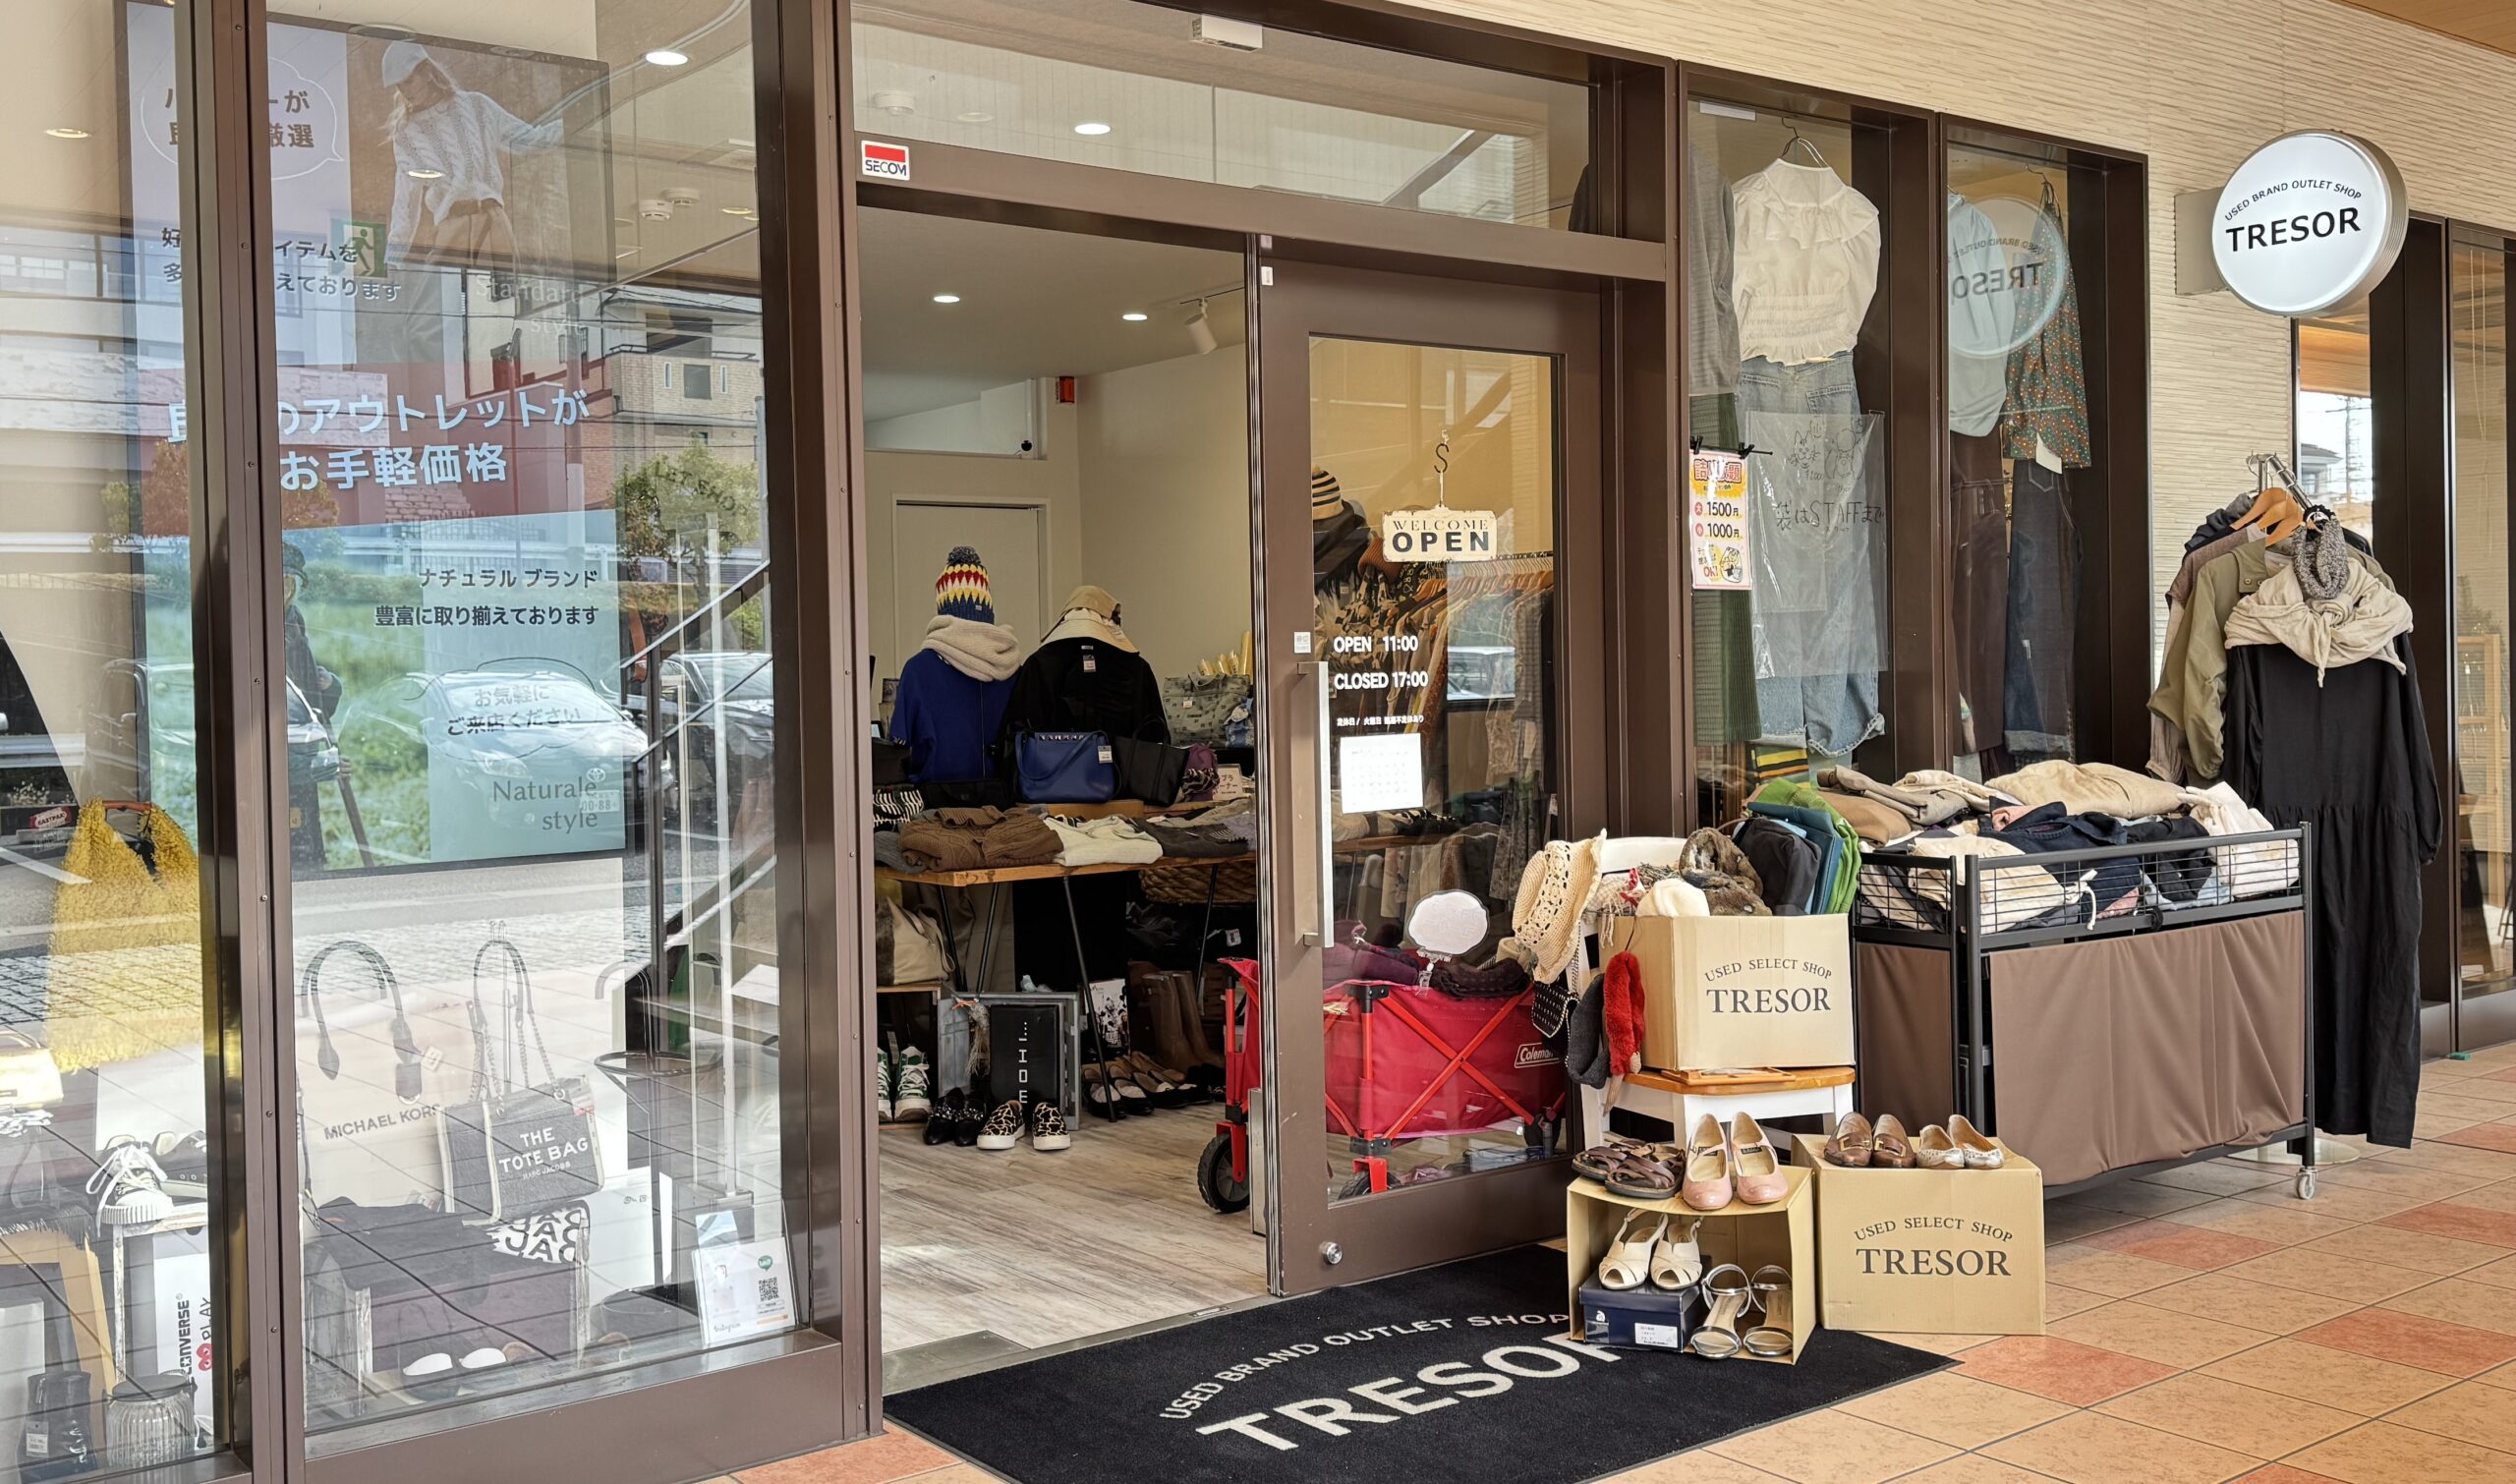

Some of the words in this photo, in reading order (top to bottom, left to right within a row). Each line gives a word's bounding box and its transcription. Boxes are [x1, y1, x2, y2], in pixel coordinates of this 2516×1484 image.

[865, 159, 907, 177] SECOM
[2225, 200, 2250, 221] USED
[2252, 182, 2289, 202] BRAND
[2292, 179, 2332, 190] OUTLET
[2333, 183, 2362, 200] SHOP
[2225, 206, 2361, 252] TRESOR
[1393, 519, 1489, 532] WELCOME
[1392, 532, 1490, 552] OPEN
[420, 569, 516, 588] ナチュラル
[525, 568, 598, 588] ブランド
[375, 605, 599, 626] 豊富に取り揃えております
[1334, 636, 1372, 653] OPEN
[1383, 635, 1418, 653] 11:00
[1334, 671, 1389, 690] CLOSED
[1392, 670, 1428, 688] 17:00
[493, 776, 597, 802] Naturale
[542, 811, 598, 833] style
[1704, 962, 1742, 982] USED
[1748, 958, 1798, 970] SELECT
[1802, 961, 1832, 980] SHOP
[1706, 987, 1831, 1013] TRESOR
[1519, 1047, 1553, 1061] Coleman
[324, 1113, 397, 1140] MICHAEL
[520, 1127, 555, 1148] THE
[499, 1150, 543, 1173] TOTE
[548, 1137, 589, 1160] BAG
[1854, 1220, 1897, 1241] USED
[1904, 1217, 1964, 1229] SELECT
[1972, 1222, 2013, 1243] SHOP
[1856, 1248, 2012, 1277] TRESOR
[177, 1299, 192, 1376] CONVERSE
[1160, 1381, 1224, 1421] USED
[1215, 1342, 1320, 1383] BRAND
[1323, 1317, 1453, 1346] OUTLET
[1467, 1313, 1570, 1327] SHOP
